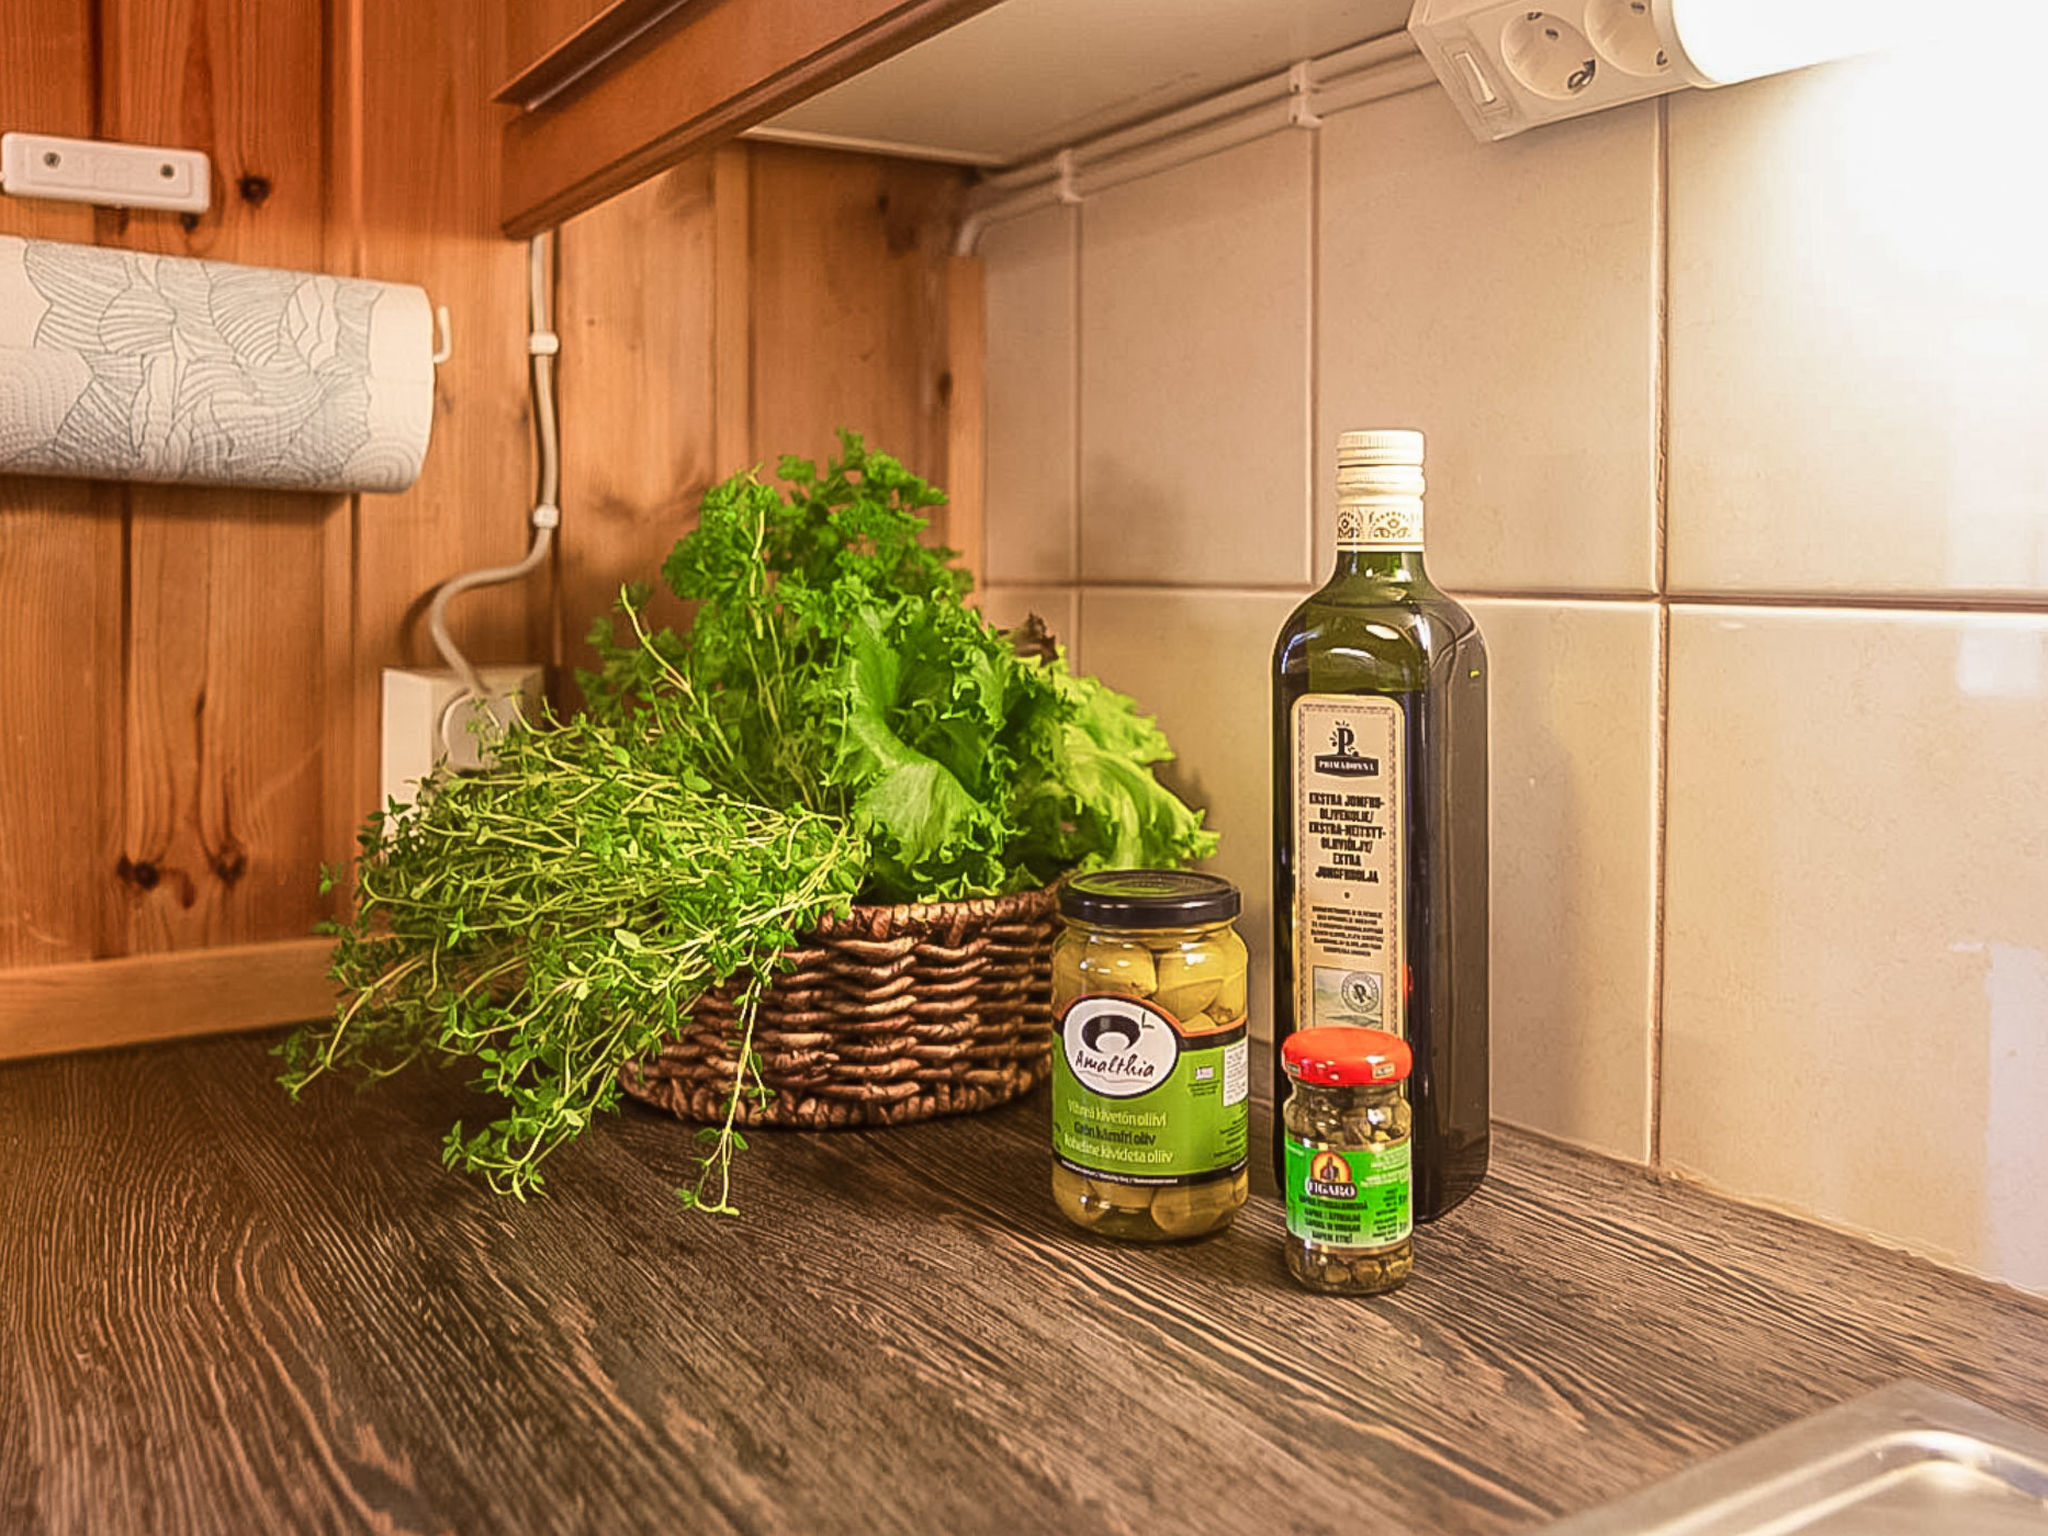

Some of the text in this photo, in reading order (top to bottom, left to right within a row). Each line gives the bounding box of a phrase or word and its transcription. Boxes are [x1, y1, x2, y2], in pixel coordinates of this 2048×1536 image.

[1308, 791, 1342, 806] EKSTRA
[1332, 852, 1362, 866] EXTRA
[1075, 1050, 1155, 1077] Amalthia
[1308, 1181, 1356, 1198] FIGARO
